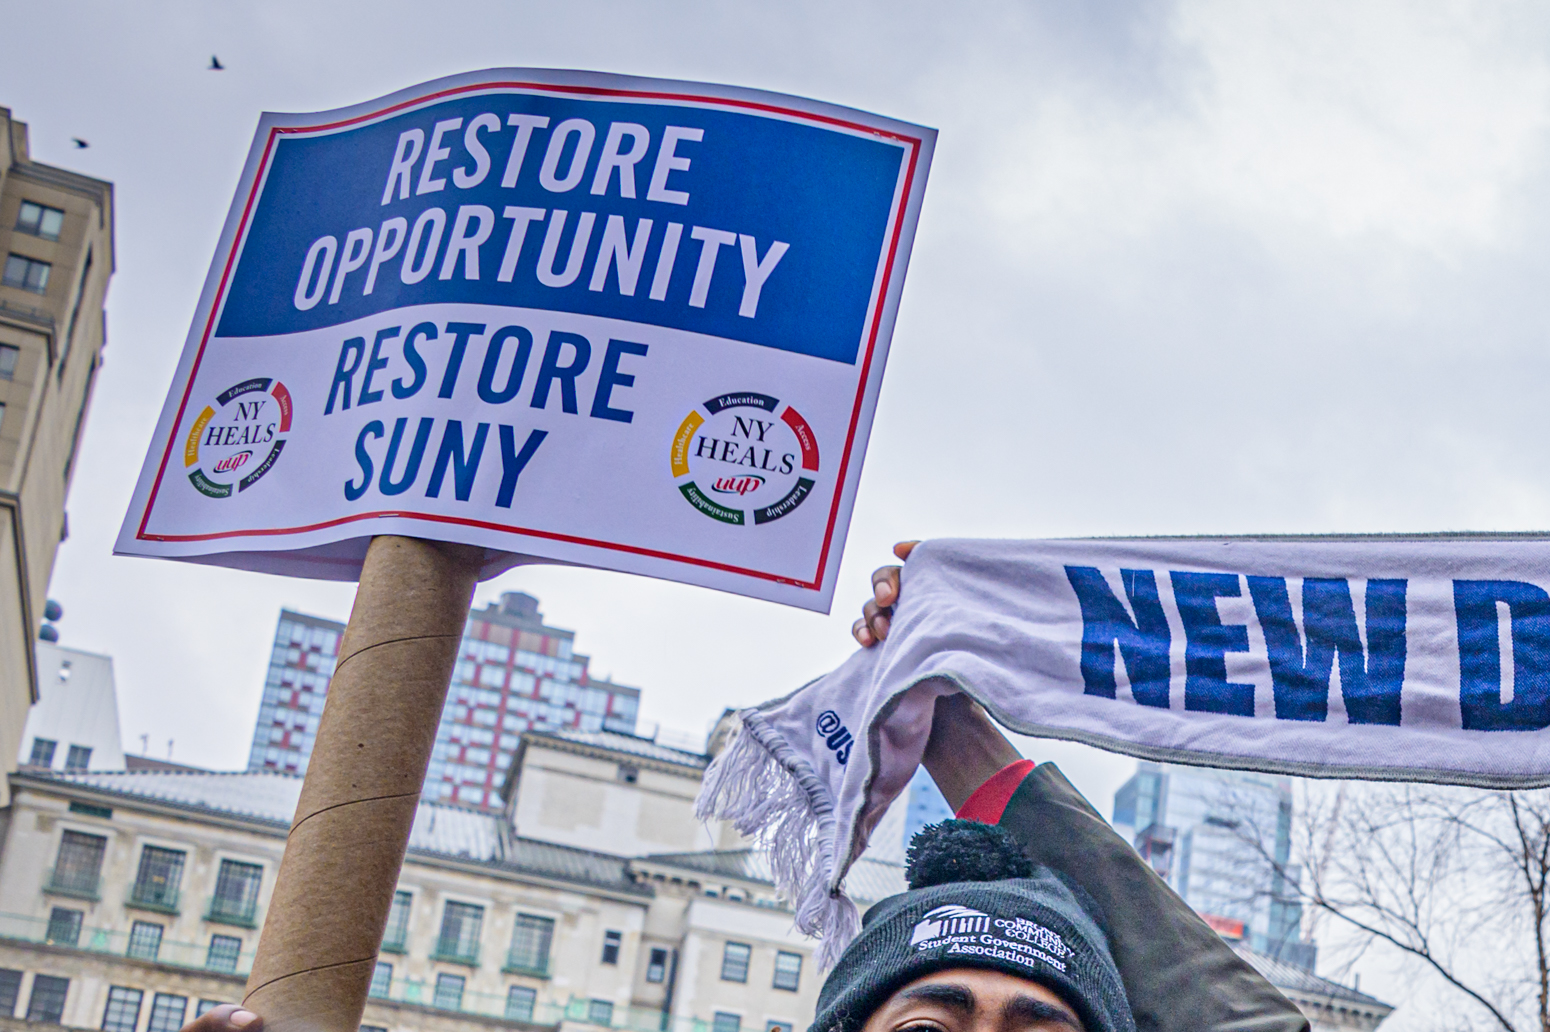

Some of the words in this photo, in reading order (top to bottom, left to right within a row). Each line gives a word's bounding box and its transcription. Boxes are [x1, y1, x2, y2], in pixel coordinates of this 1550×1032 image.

[383, 113, 705, 206] RESTORE
[293, 204, 791, 319] OPPORTUNITY
[322, 321, 651, 424] RESTORE
[233, 400, 267, 421] NY
[718, 396, 765, 408] Education
[204, 422, 276, 446] HEALS
[674, 422, 694, 465] Healthcare
[730, 415, 775, 443] NY
[795, 424, 811, 451] Access
[247, 448, 280, 483] Leadership
[343, 416, 549, 509] SUNY
[694, 435, 796, 475] HEALS
[686, 486, 740, 523] Sustainability
[715, 477, 760, 496] uup
[765, 485, 807, 517] Leadership
[1064, 565, 1407, 726] NEW
[918, 935, 977, 951] Student
[980, 934, 1067, 972] Government
[947, 942, 1035, 968] Association
[994, 918, 1075, 958] COMMUNITY
[1005, 928, 1066, 958] COLLEGE
